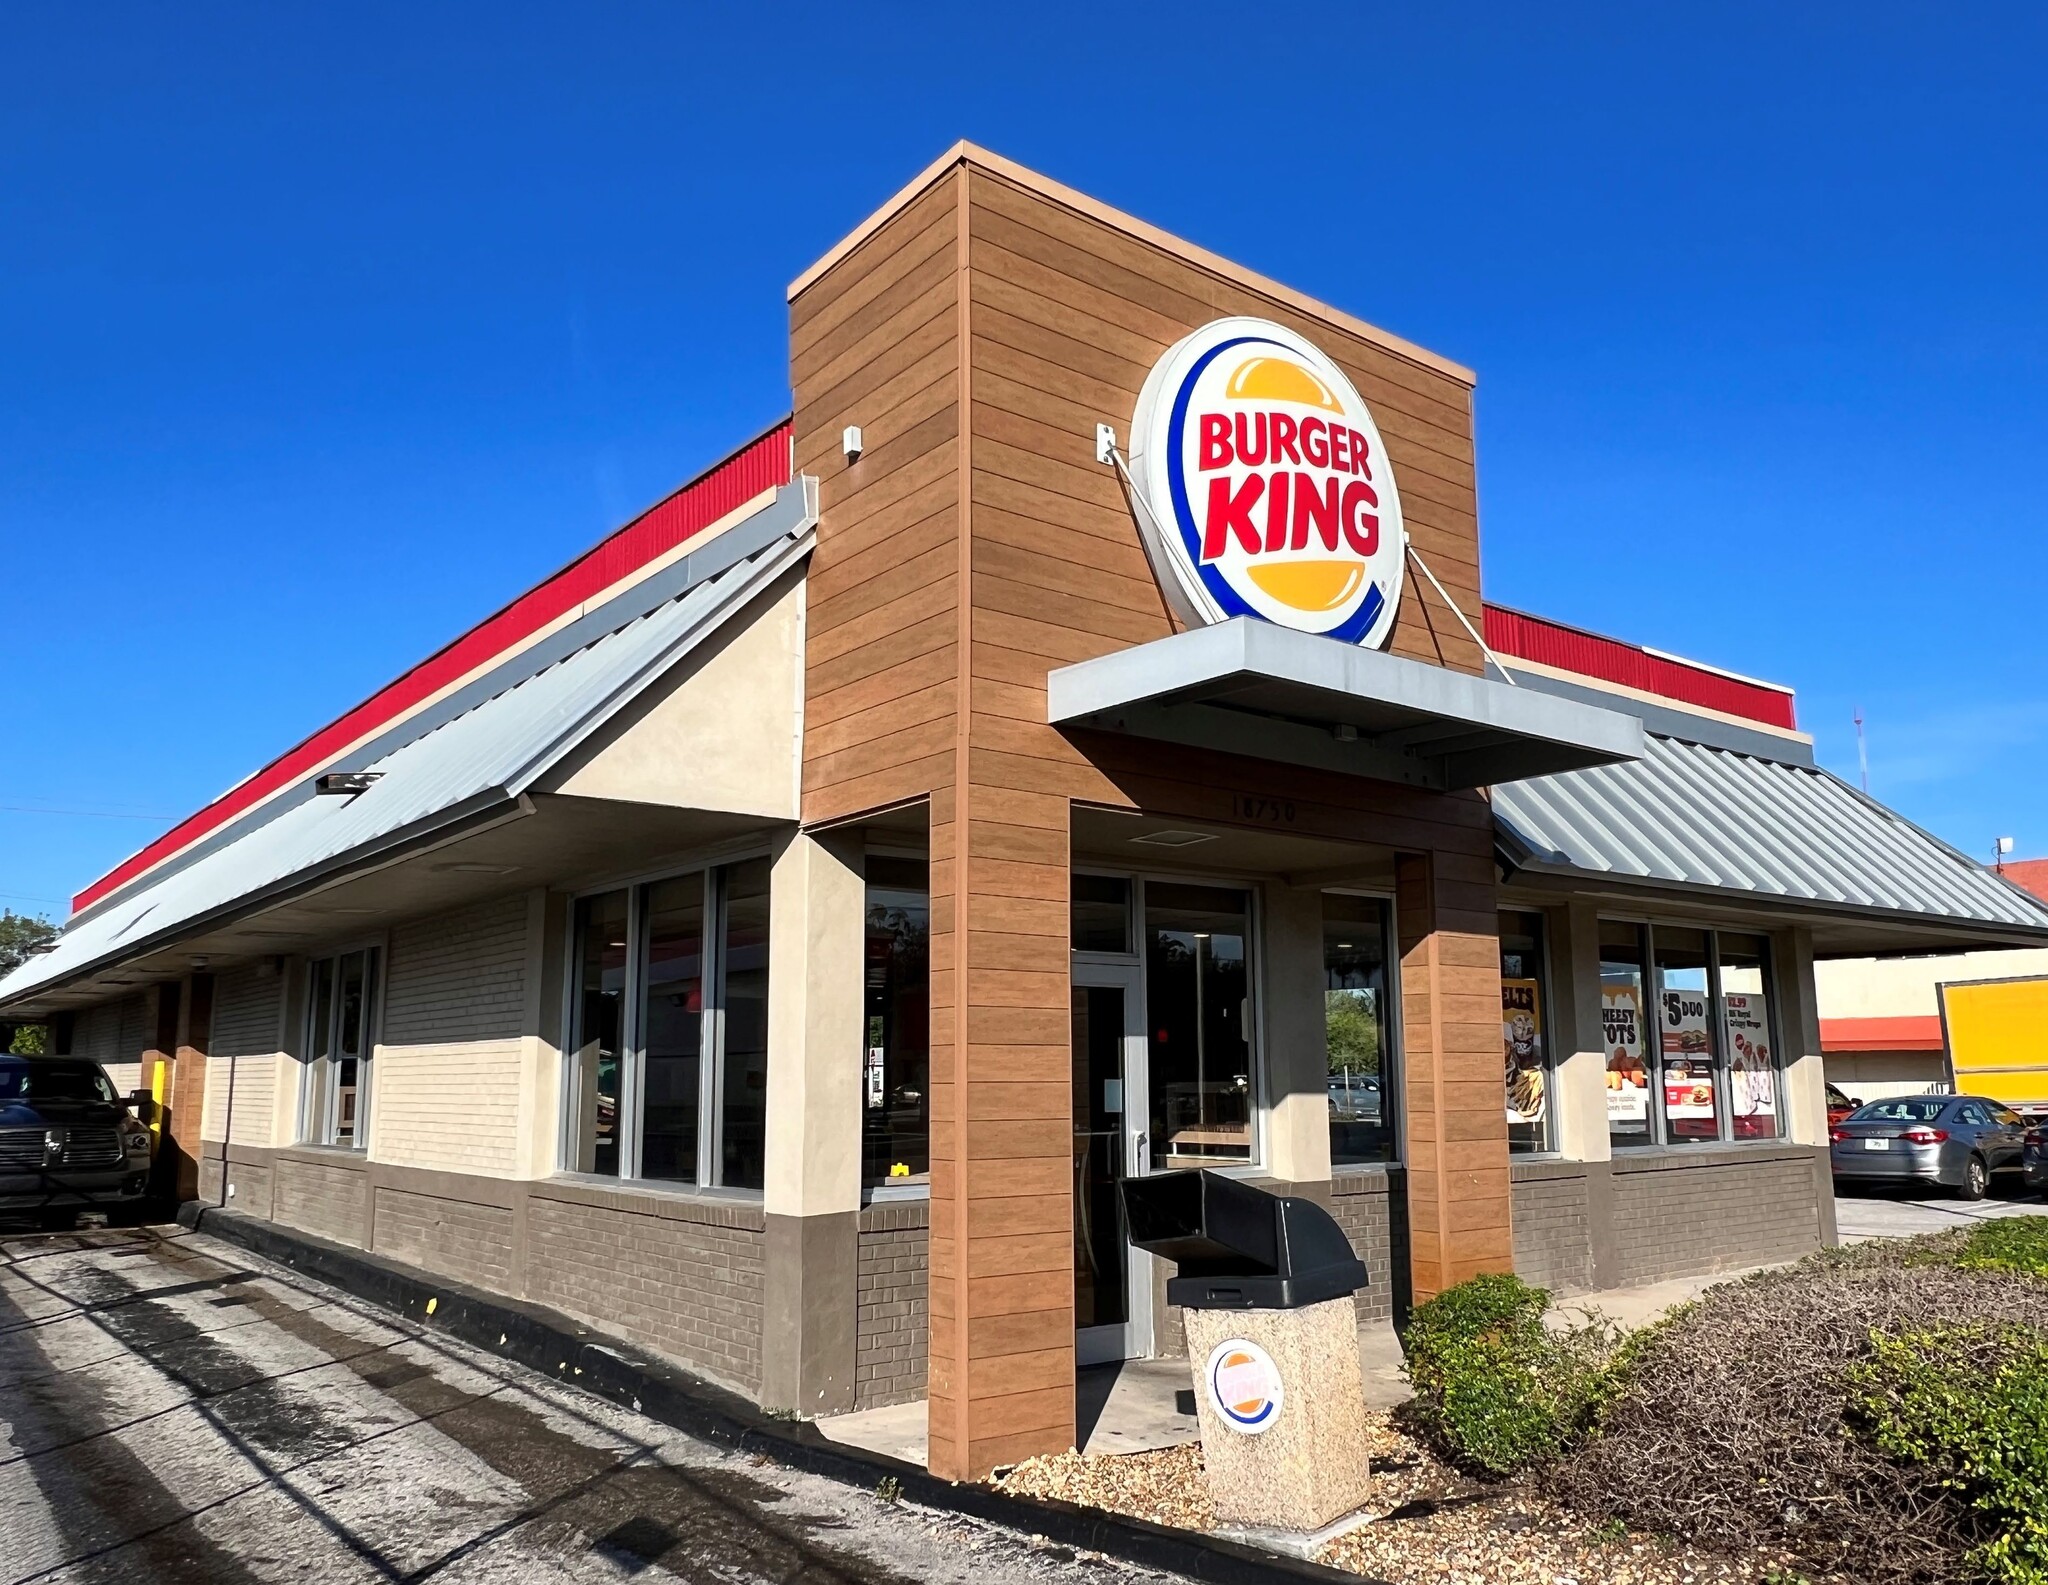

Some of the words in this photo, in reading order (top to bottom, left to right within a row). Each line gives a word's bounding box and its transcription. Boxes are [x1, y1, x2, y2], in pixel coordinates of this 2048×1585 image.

[1199, 411, 1373, 482] BURGER
[1202, 471, 1379, 560] KING
[1681, 1001, 1704, 1017] DUO
